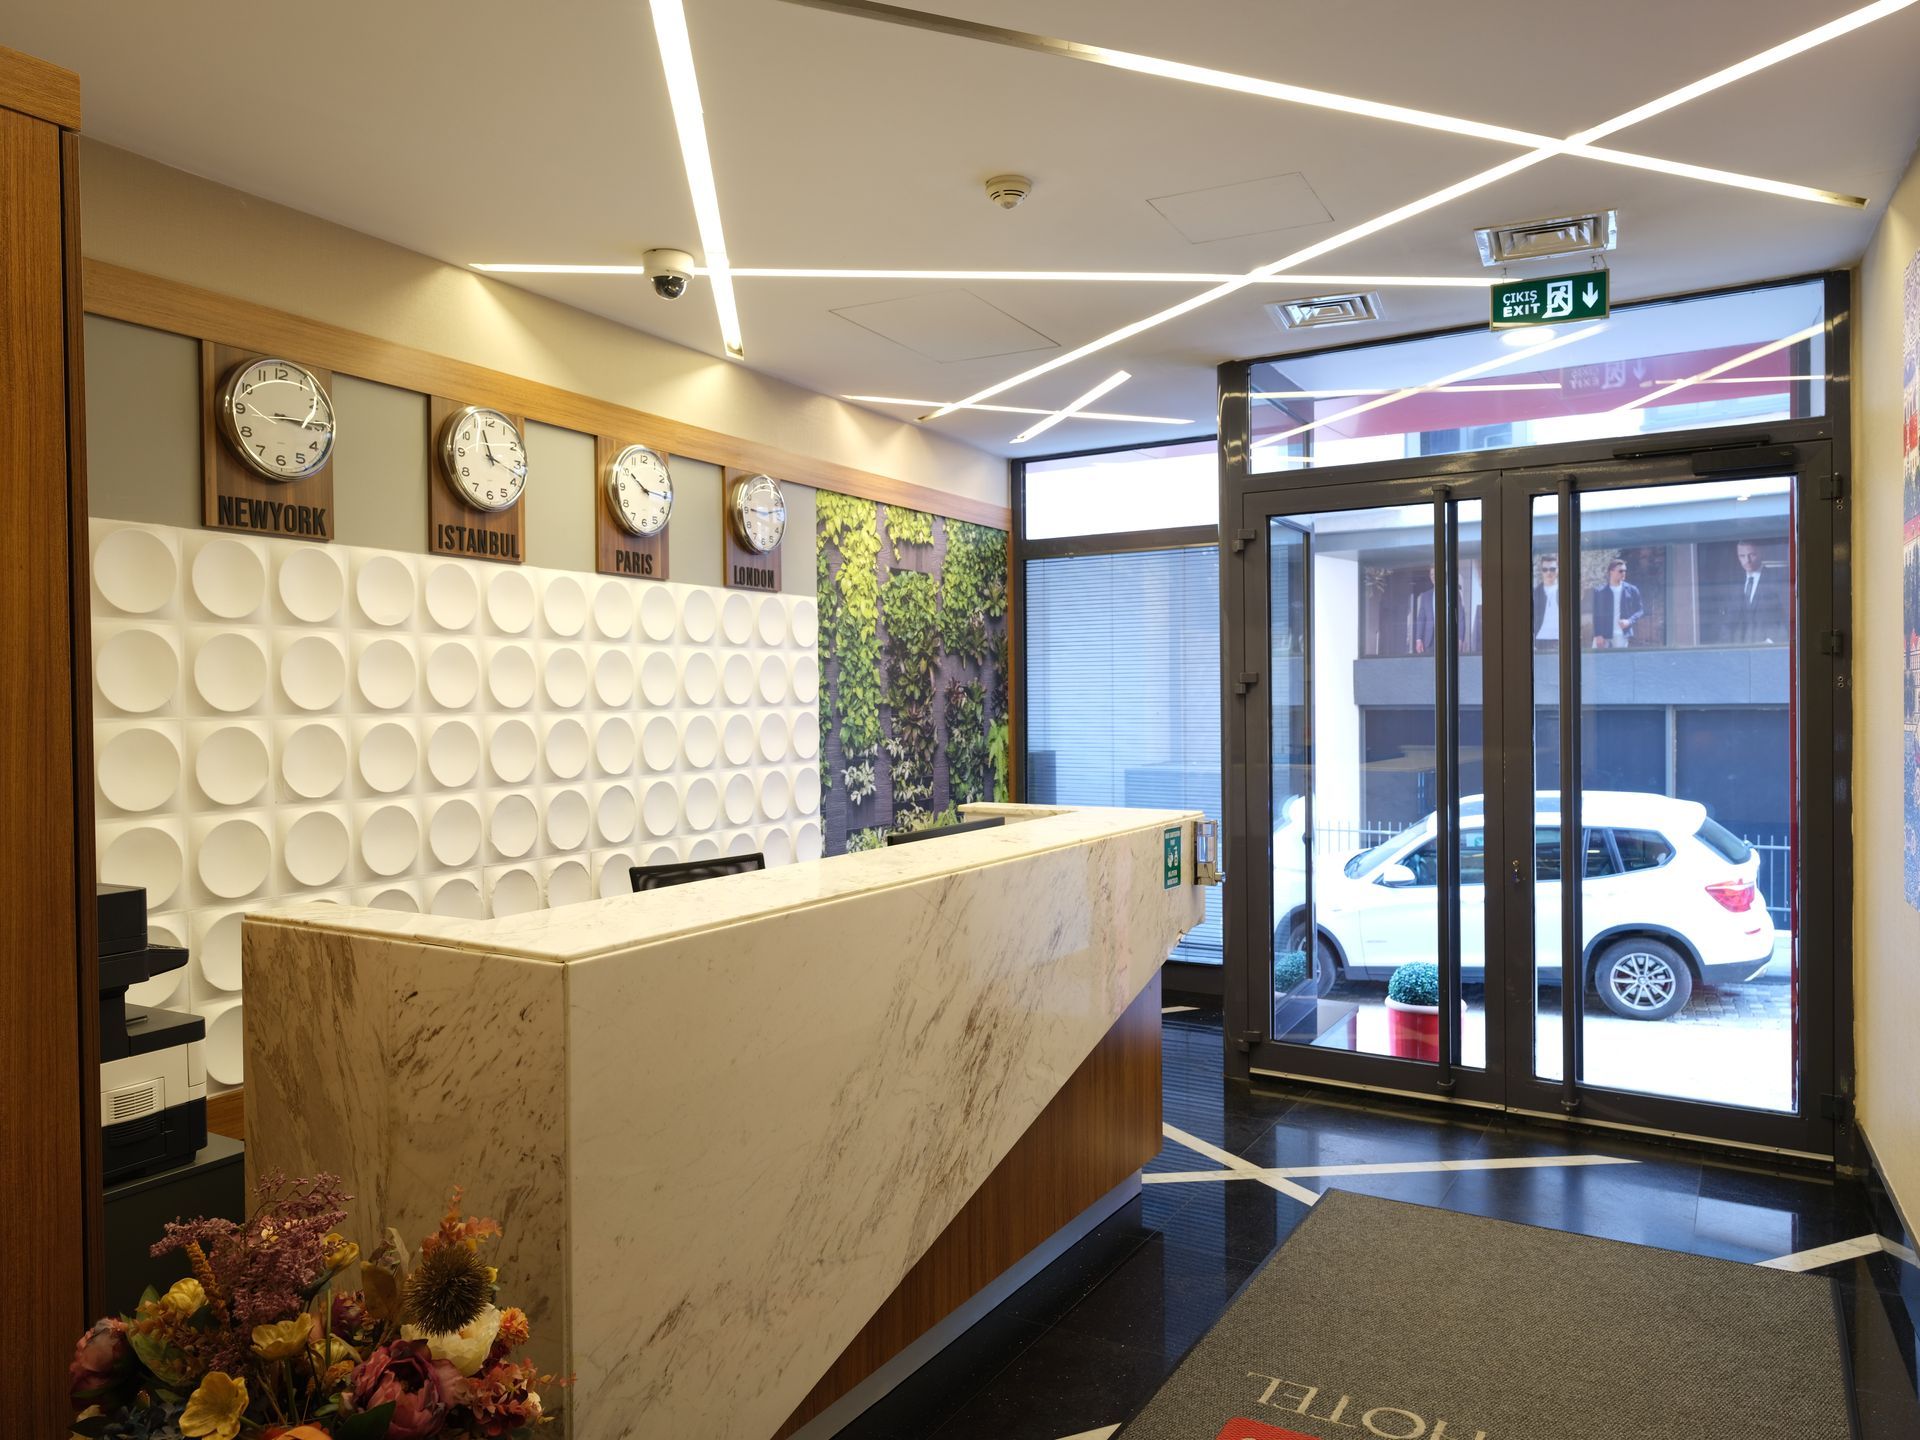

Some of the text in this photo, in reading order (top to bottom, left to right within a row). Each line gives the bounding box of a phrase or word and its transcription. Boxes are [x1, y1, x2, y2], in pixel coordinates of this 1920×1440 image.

[1503, 290, 1538, 306] ÇIKIŞ
[1503, 303, 1541, 318] EXIT
[258, 369, 266, 381] 11
[275, 368, 288, 381] 12
[242, 383, 253, 395] 10
[235, 402, 246, 414] 9
[485, 417, 495, 428] 12
[240, 426, 252, 438] 8
[462, 431, 470, 440] 10
[256, 445, 266, 456] 7
[309, 441, 319, 451] 4
[510, 441, 517, 451] 2
[458, 447, 465, 457] 9
[276, 455, 286, 466] 6
[296, 453, 306, 465] 5
[631, 456, 636, 466] 11
[641, 455, 648, 464] 12
[462, 467, 470, 477] 8
[510, 478, 517, 487] 4
[659, 475, 665, 483] 2
[472, 482, 479, 492] 7
[620, 483, 625, 491] 9
[486, 490, 494, 500] 6
[500, 488, 508, 498] 5
[623, 499, 629, 508] 8
[659, 506, 665, 514] 4
[218, 495, 327, 537] NEWYORK
[631, 512, 636, 521] 7
[652, 516, 658, 524] 5
[641, 518, 647, 527] 6
[438, 524, 521, 558] ISTANBUL
[616, 549, 653, 575] PARIS
[734, 565, 775, 588] LONDON
